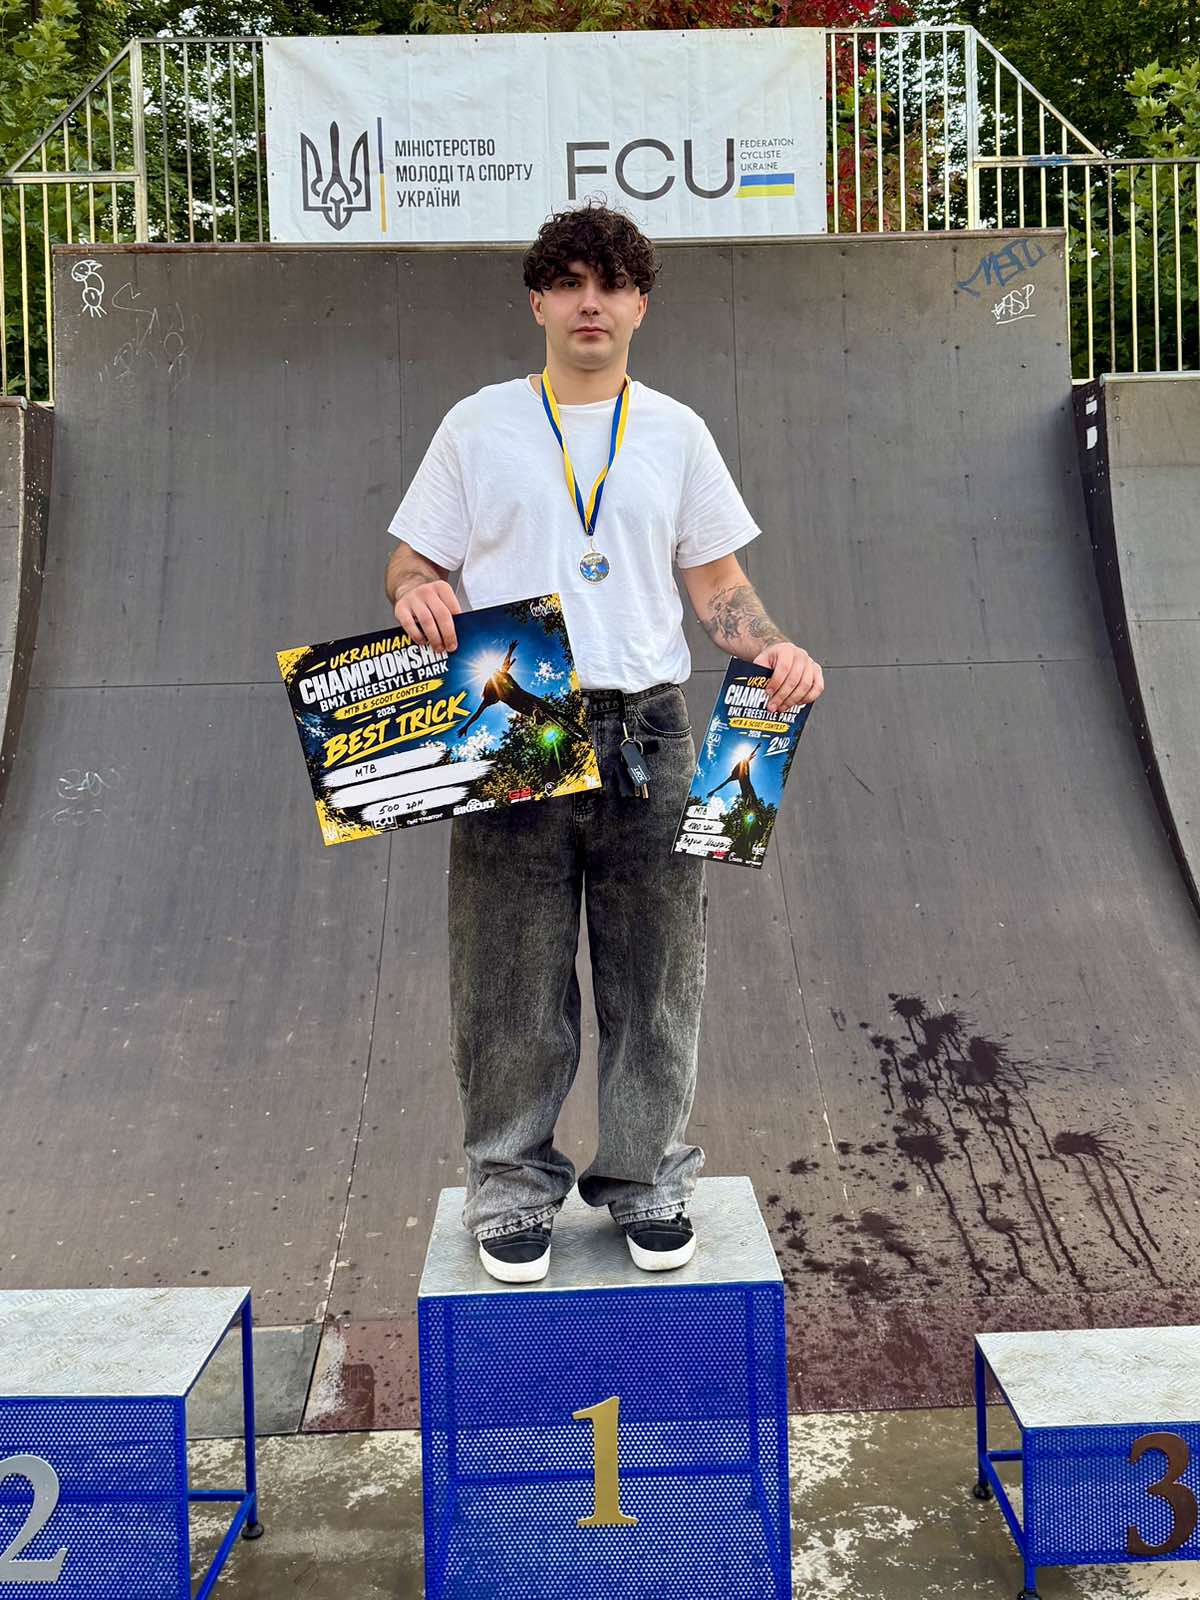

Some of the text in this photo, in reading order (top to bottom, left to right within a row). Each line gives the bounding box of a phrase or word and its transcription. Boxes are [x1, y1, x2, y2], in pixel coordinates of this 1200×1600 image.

[395, 139, 495, 157] МІНІСТЕРСТВО
[740, 138, 794, 148] FEDERATION
[739, 150, 781, 160] CYCLISTE
[396, 163, 533, 183] МОЛОДІ ТА СПОРТУ
[566, 138, 735, 201] FCU
[740, 162, 778, 171] UKRAINE
[396, 187, 460, 208] УКРАЇНИ
[330, 634, 412, 669] UKRAINIAN
[320, 661, 449, 713] BMX FREESTYLE PARK
[344, 704, 360, 716] MTB
[370, 695, 393, 708] SCOOT
[396, 683, 430, 699] CONTEST
[727, 706, 743, 716] BMX
[778, 711, 798, 724] PARK
[321, 718, 391, 769] BEST
[766, 737, 791, 753] 2ND
[379, 803, 400, 816] 500
[572, 1396, 640, 1526] 1
[1127, 1431, 1198, 1555] 3
[0, 1454, 68, 1582] 2
